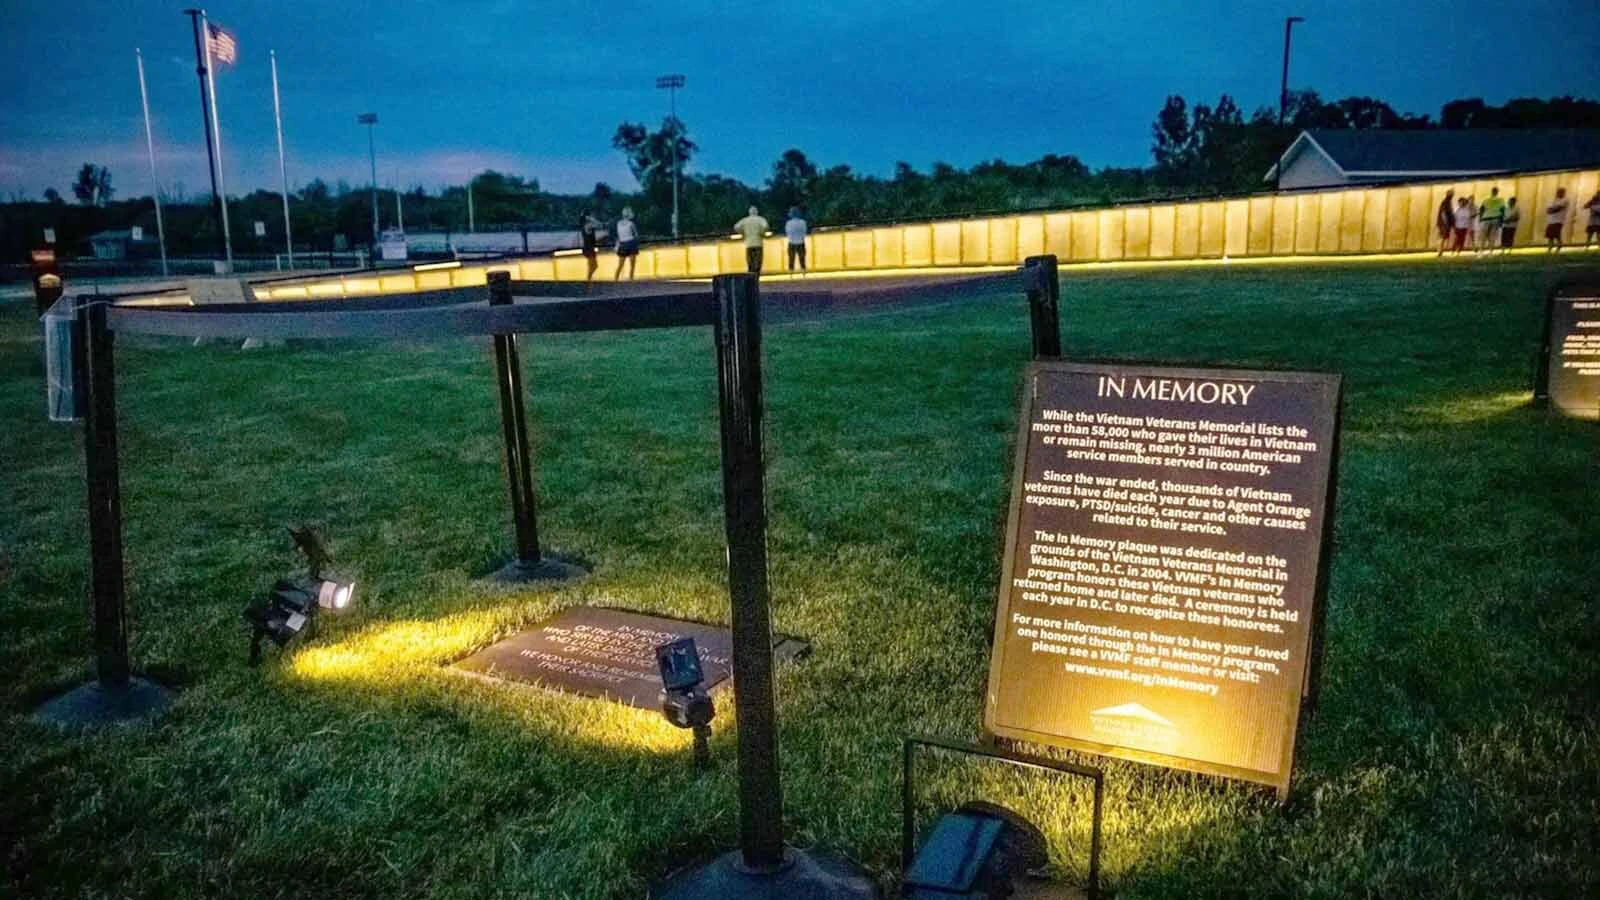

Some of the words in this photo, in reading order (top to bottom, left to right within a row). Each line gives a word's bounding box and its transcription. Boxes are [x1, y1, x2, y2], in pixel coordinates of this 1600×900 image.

[1097, 377, 1125, 397] IN
[1132, 379, 1253, 406] MEMORY
[1031, 423, 1061, 432] more
[1062, 423, 1089, 434] than
[1091, 425, 1129, 437] 58,000
[1130, 428, 1156, 439] who
[1157, 432, 1186, 442] gave
[1187, 432, 1217, 444] their
[1219, 434, 1247, 446] lives
[1249, 436, 1262, 447] in
[1263, 437, 1317, 451] Vietnam
[1042, 409, 1073, 421] While
[1074, 412, 1094, 422] the
[1095, 413, 1143, 426] Vietnam
[1144, 416, 1196, 429] Veterans
[1198, 420, 1256, 433] Memorial
[1257, 424, 1284, 435] lists
[1285, 426, 1308, 437] the
[1042, 435, 1055, 444] or
[1056, 437, 1097, 447] remain
[1098, 439, 1145, 453] missing,
[1148, 443, 1186, 457] nearly
[1187, 444, 1195, 455] 3
[1197, 446, 1240, 458] million
[1241, 448, 1301, 463] American
[1066, 449, 1106, 460] service
[1107, 453, 1162, 465] members
[1163, 457, 1204, 468] served
[1205, 458, 1218, 469] in
[1219, 462, 1269, 476] country.
[1023, 482, 1071, 494] veterans
[1073, 485, 1100, 497] have
[1102, 488, 1128, 499] died
[1129, 492, 1157, 502] each
[1158, 495, 1185, 506] year
[1187, 495, 1210, 507] due
[1211, 498, 1225, 509] to
[1226, 499, 1263, 513] Agent
[1265, 502, 1311, 519] Orange
[1042, 470, 1072, 482] Since
[1074, 473, 1093, 484] the
[1095, 477, 1117, 486] war
[1119, 478, 1158, 491] ended,
[1160, 481, 1223, 495] thousands
[1224, 486, 1239, 497] of
[1239, 487, 1292, 502] Vietnam
[1025, 495, 1079, 509] exposure,
[1081, 498, 1158, 517] PTSD/suicide,
[1160, 508, 1200, 519] cancer
[1202, 511, 1226, 522] and
[1227, 513, 1261, 525] other
[1263, 517, 1306, 529] causes
[1092, 513, 1134, 525] related
[1135, 516, 1148, 527] to
[1149, 518, 1179, 530] their
[1180, 522, 1226, 535] service.
[1029, 544, 1075, 556] grounds
[1076, 548, 1089, 558] of
[1090, 549, 1110, 560] the
[1111, 551, 1159, 566] Vietnam
[1161, 556, 1213, 572] Veterans
[1215, 562, 1273, 579] Memorial
[1275, 569, 1288, 580] in
[1033, 530, 1055, 542] The
[1056, 533, 1068, 543] In
[1069, 534, 1116, 551] Memory
[1117, 540, 1158, 554] plaque
[1159, 545, 1183, 556] was
[1184, 546, 1245, 562] dedicated
[1246, 555, 1263, 565] on
[1264, 555, 1287, 567] the
[1026, 568, 1074, 581] program
[1076, 572, 1116, 586] honors
[1117, 577, 1149, 590] these
[1151, 581, 1200, 596] Vietnam
[1202, 589, 1255, 603] veterans
[1256, 594, 1285, 607] who
[1030, 554, 1099, 573] Washington,
[1101, 562, 1124, 574] D.C.
[1126, 565, 1138, 576] in
[1140, 567, 1171, 580] 2004.
[1174, 571, 1216, 585] VVMF's
[1218, 576, 1231, 587] In
[1233, 577, 1284, 596] Memory
[1012, 578, 1061, 591] returned
[1063, 582, 1095, 596] home
[1096, 588, 1118, 599] and
[1120, 590, 1148, 603] later
[1150, 593, 1179, 607] died.
[1184, 597, 1193, 608] A
[1194, 601, 1255, 619] ceremony
[1256, 606, 1268, 618] is
[1269, 608, 1298, 621] held
[1021, 591, 1048, 602] each
[1049, 595, 1074, 606] year
[1076, 597, 1088, 607] in
[1089, 598, 1112, 611] D.C.
[1114, 602, 1128, 613] to
[1129, 605, 1185, 620] recognize
[1186, 611, 1220, 625] these
[1222, 615, 1283, 633] honorees.
[1012, 613, 1031, 624] For
[1032, 617, 1062, 628] more
[1063, 619, 1130, 638] information
[1132, 631, 1147, 640] on
[1149, 631, 1175, 644] how
[1176, 635, 1190, 646] to
[1191, 637, 1221, 651] have
[1222, 643, 1252, 655] your
[1253, 645, 1289, 660] loved
[1016, 627, 1038, 637] one
[1039, 629, 1086, 644] honored
[1088, 636, 1133, 652] through
[1136, 643, 1155, 654] the
[1157, 645, 1169, 656] In
[1172, 647, 1220, 666] Memory
[1222, 656, 1279, 674] program,
[1031, 641, 1067, 654] please
[1069, 647, 1088, 657] see
[1090, 650, 1098, 658] a
[1099, 649, 1130, 663] VVMF
[1133, 655, 1159, 667] staff
[1161, 660, 1210, 675] member
[1212, 668, 1226, 677] or
[1228, 669, 1259, 682] visit:
